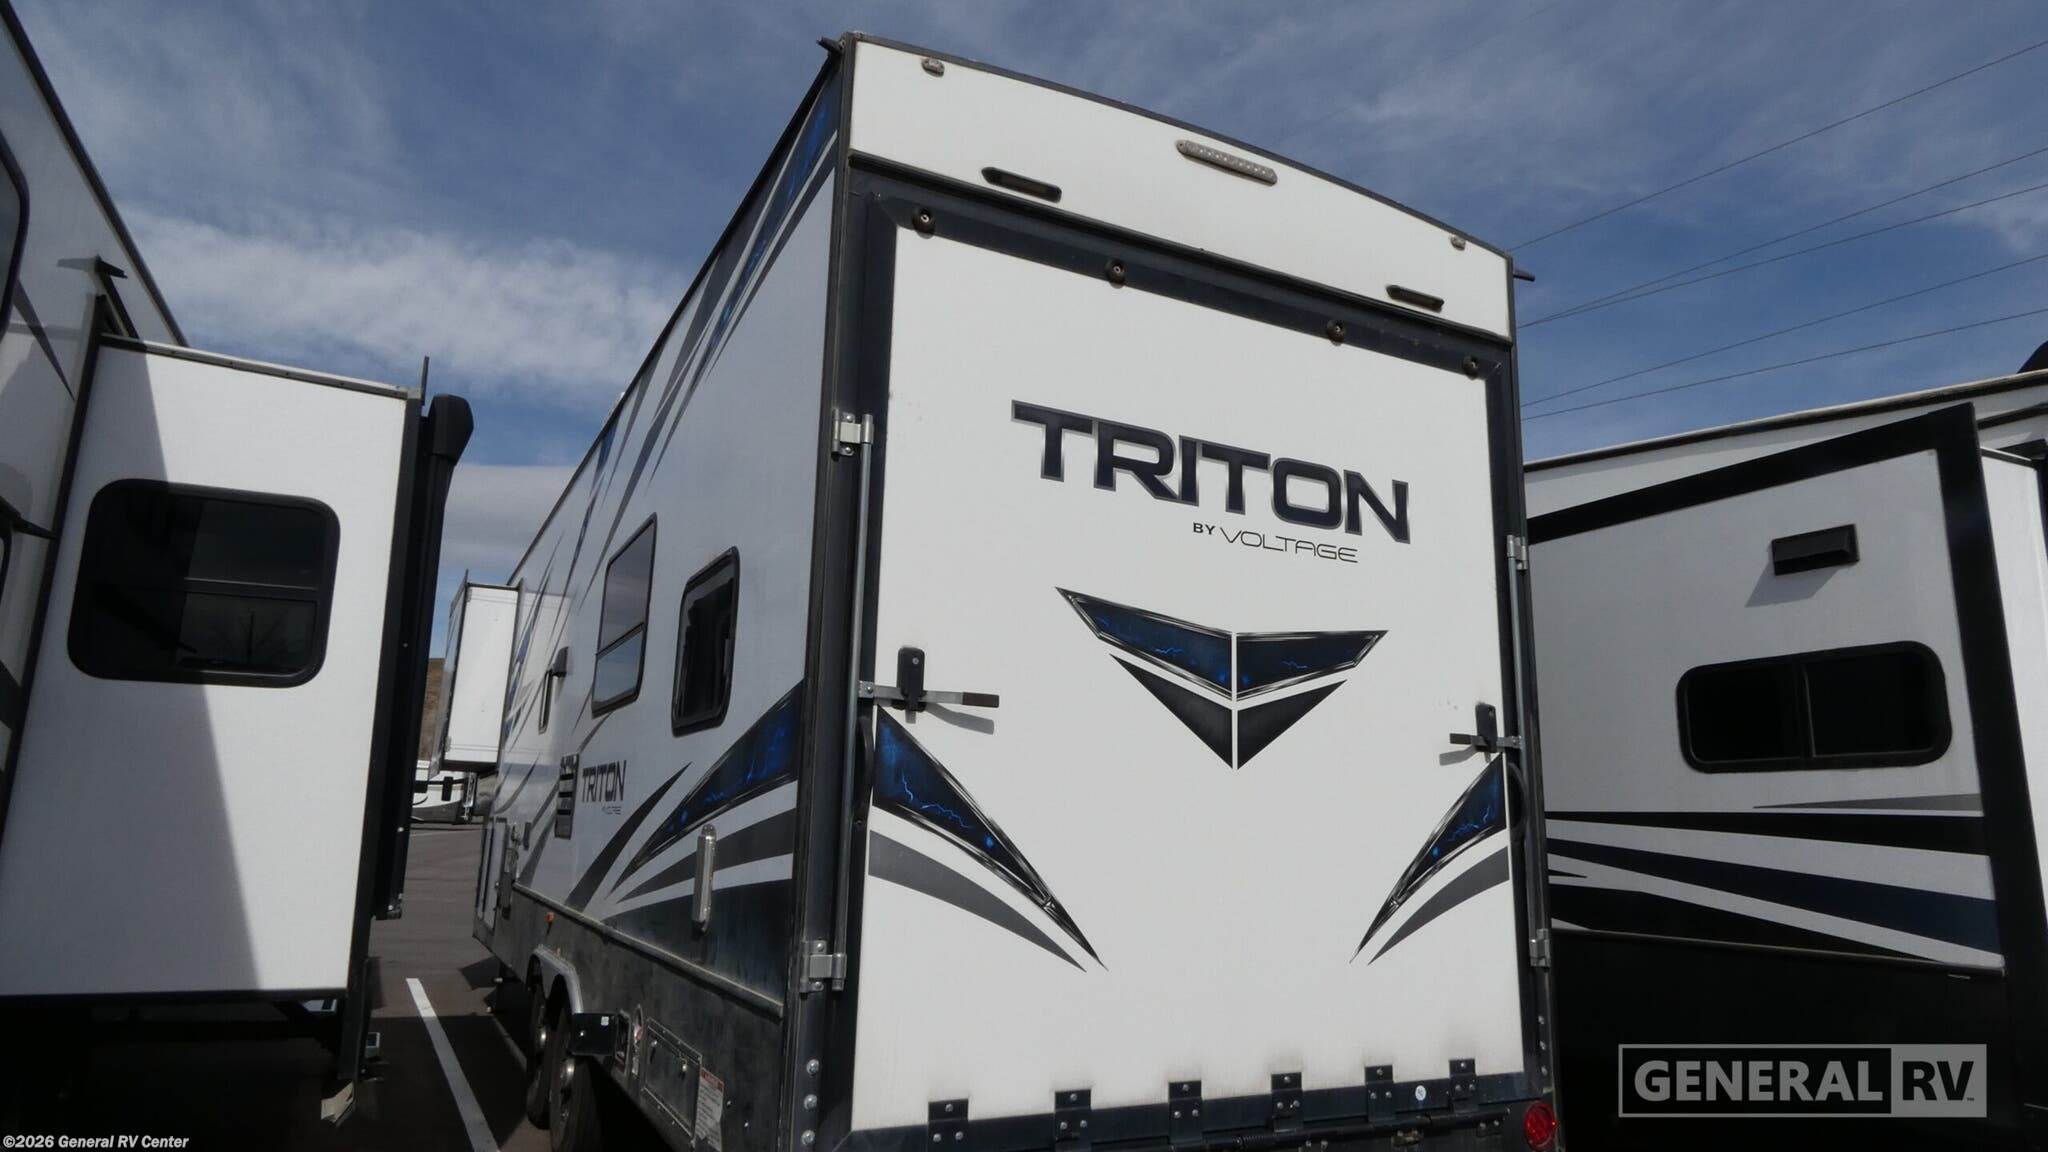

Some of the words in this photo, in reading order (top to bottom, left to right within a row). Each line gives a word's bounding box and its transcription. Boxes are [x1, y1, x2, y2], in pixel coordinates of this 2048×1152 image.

[1011, 399, 1411, 544] TRITON
[1192, 522, 1215, 535] BY
[1220, 526, 1358, 563] VOLTAGE
[582, 759, 627, 803] TRITON
